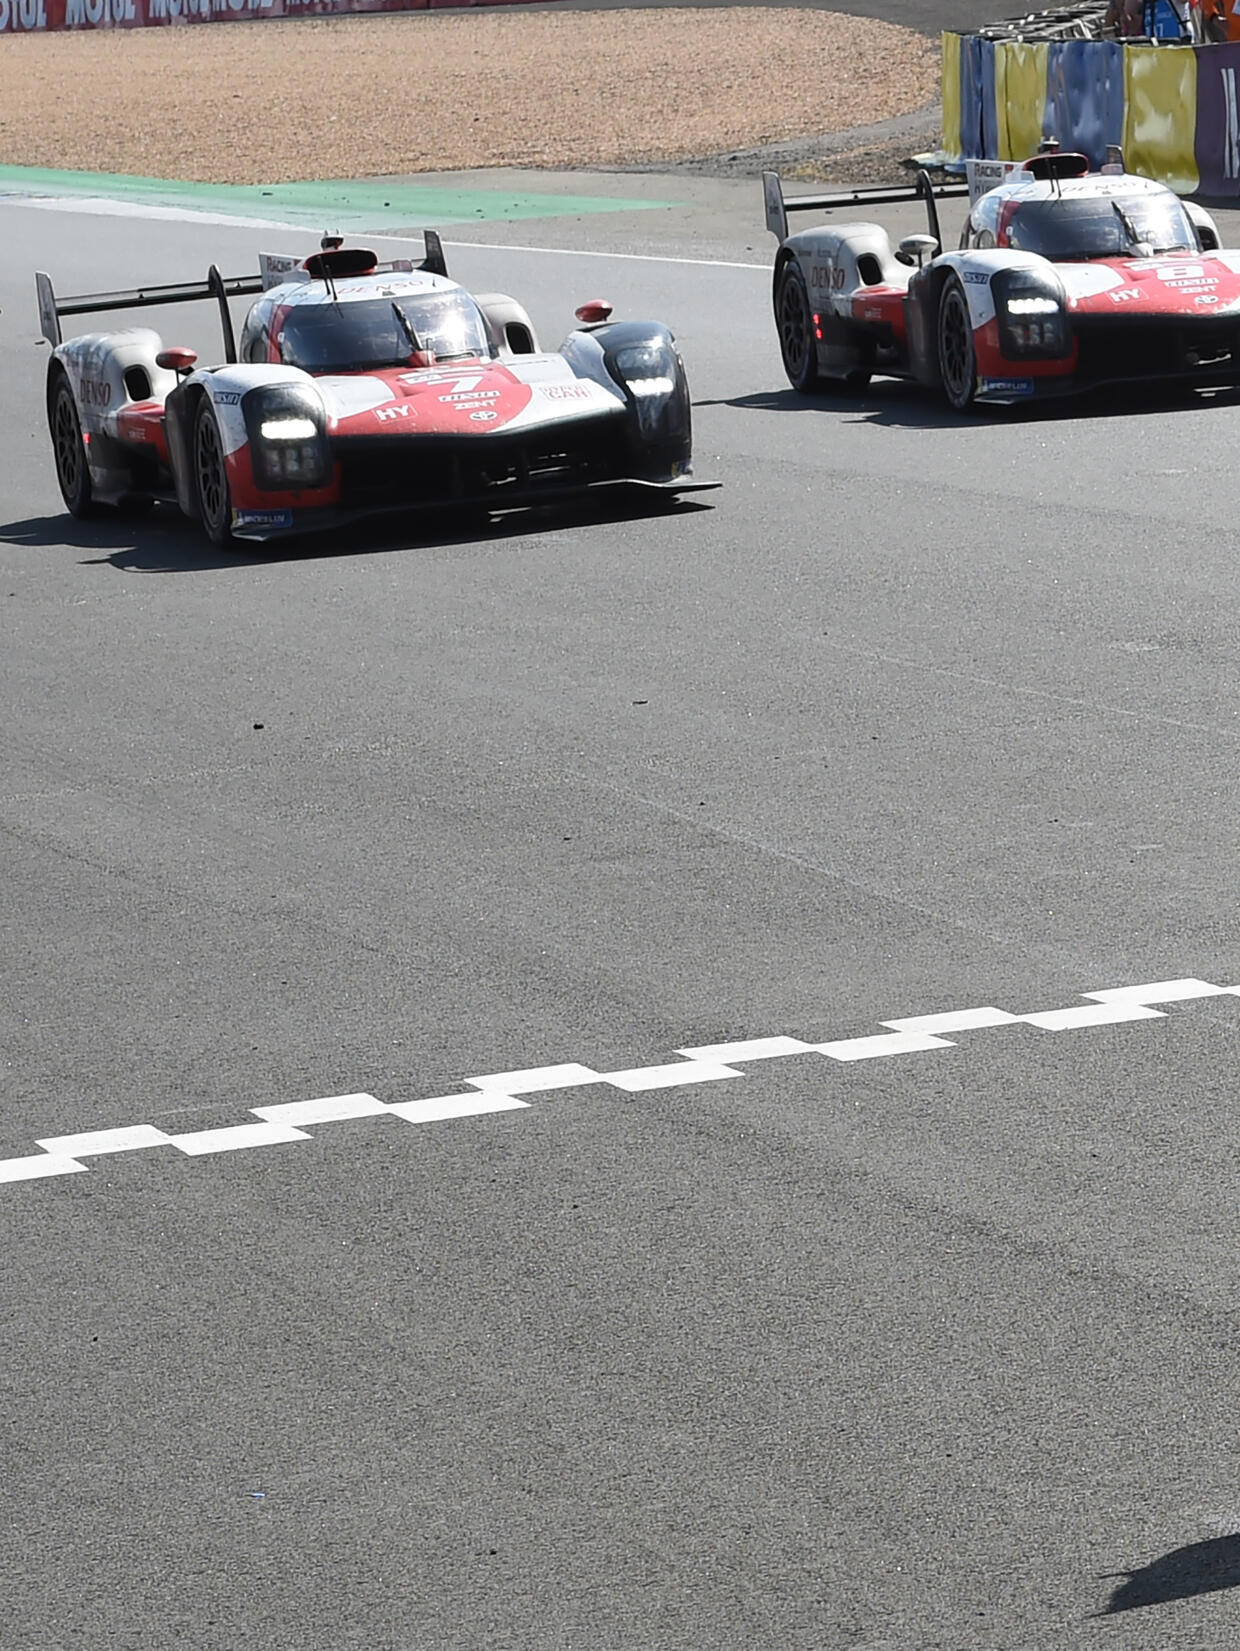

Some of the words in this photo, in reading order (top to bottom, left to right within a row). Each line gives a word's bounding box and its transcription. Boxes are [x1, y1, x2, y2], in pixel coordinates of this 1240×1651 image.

[812, 265, 845, 290] DENSO
[1156, 265, 1204, 281] 8
[1109, 288, 1140, 302] HY
[80, 379, 112, 407] DENSO
[426, 376, 484, 393] 7
[376, 404, 409, 421] HY
